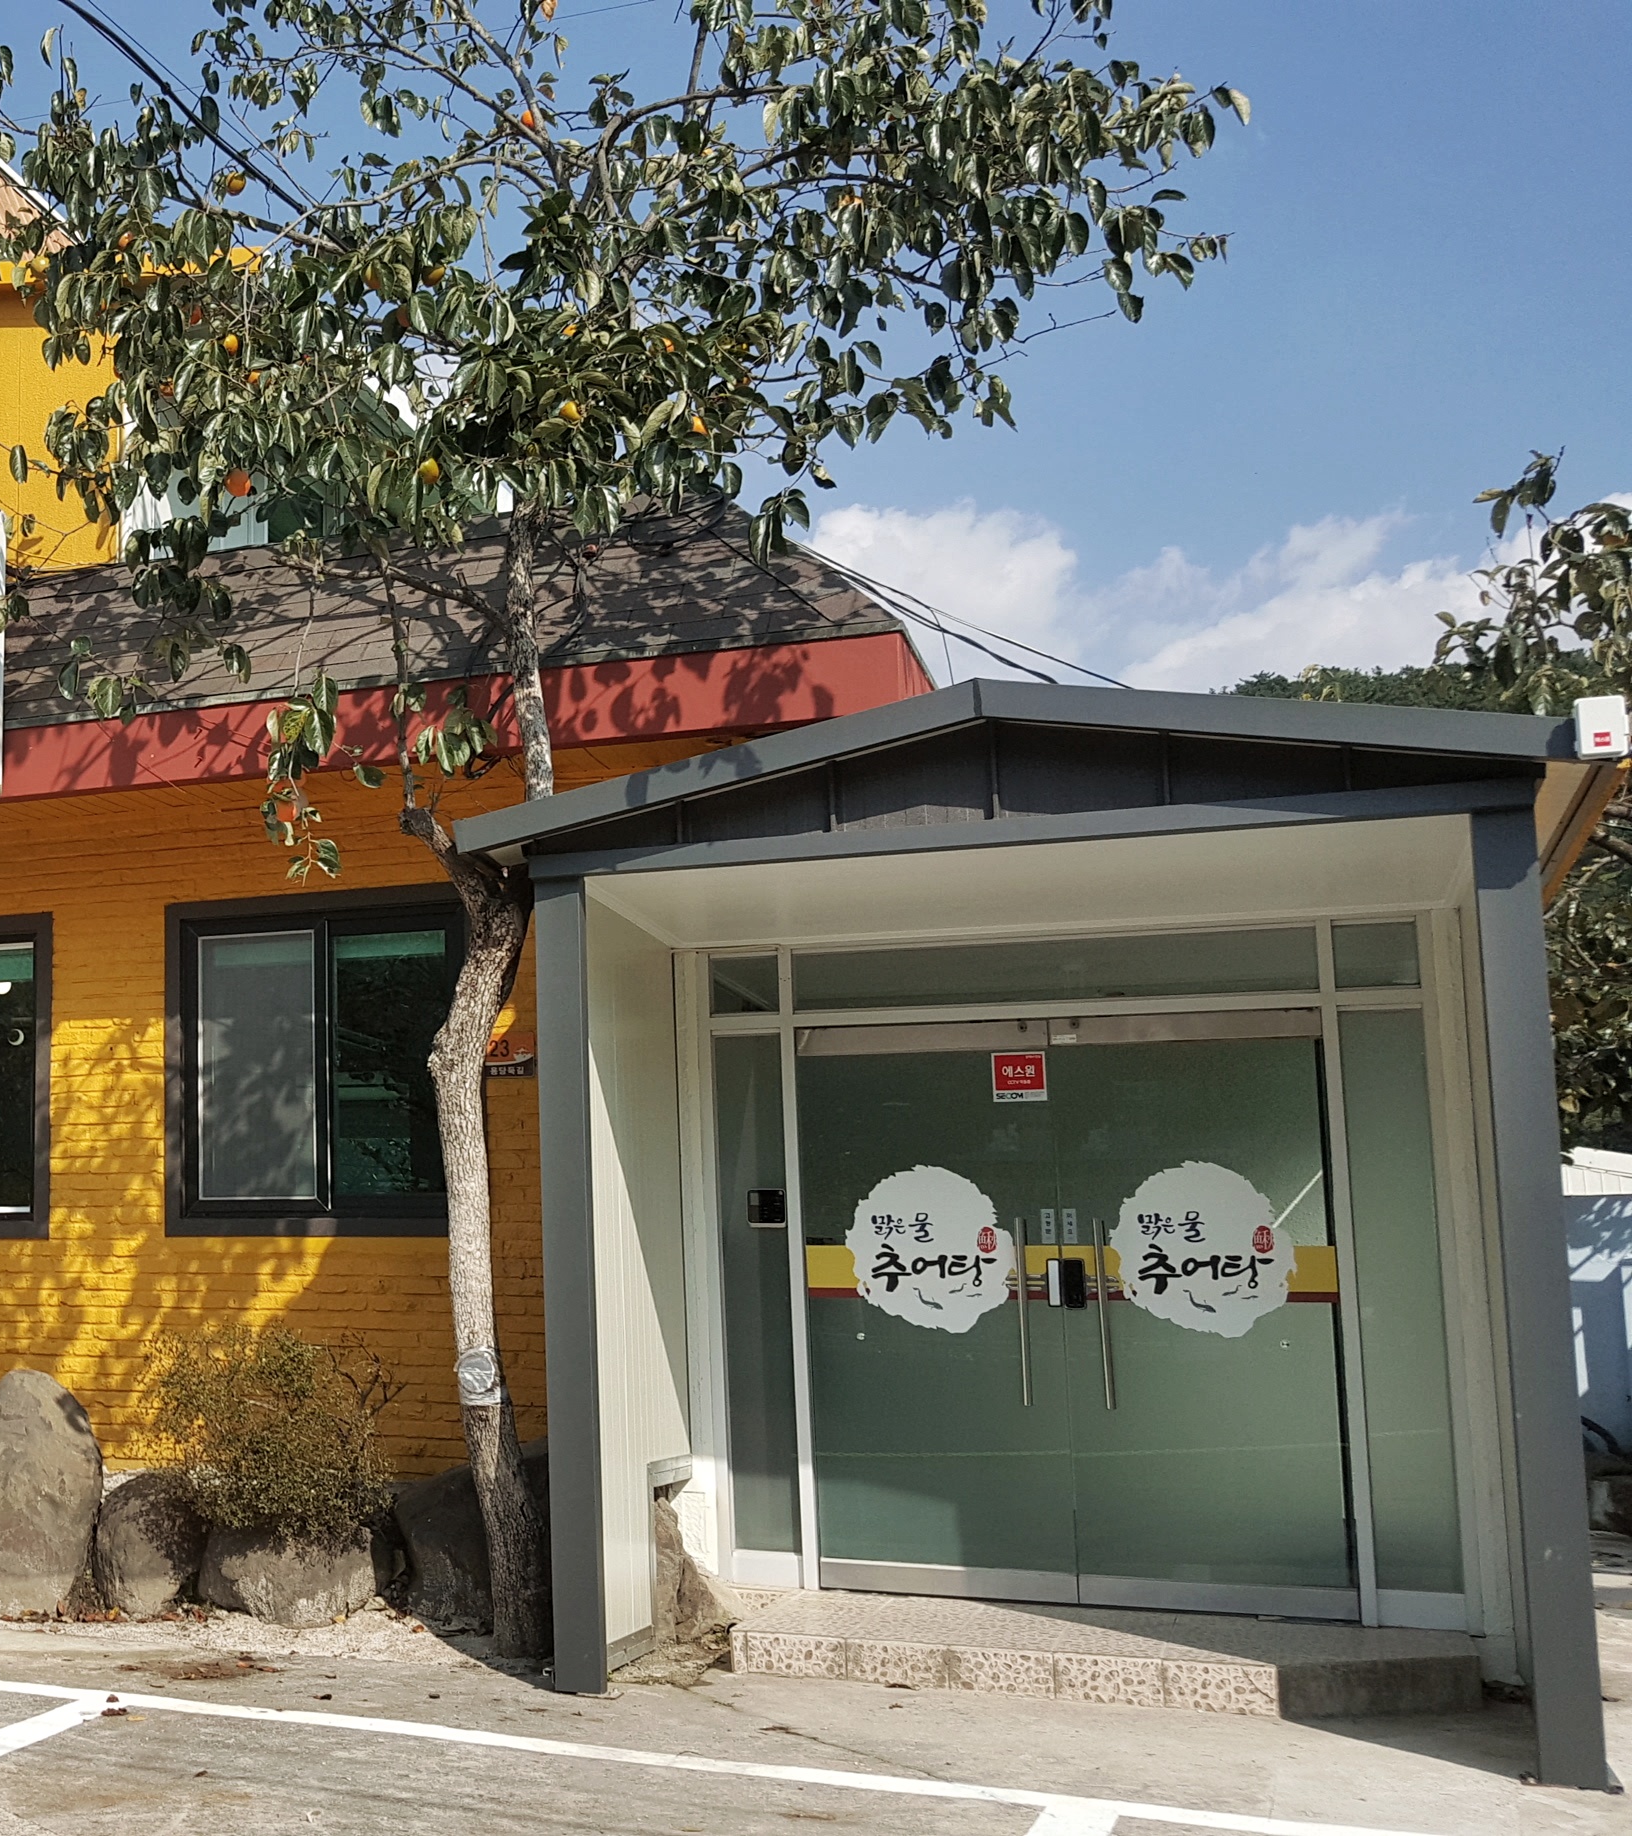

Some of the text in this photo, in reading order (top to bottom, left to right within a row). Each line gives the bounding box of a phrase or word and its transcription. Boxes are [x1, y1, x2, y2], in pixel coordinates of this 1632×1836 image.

[1002, 1065, 1035, 1077] 에스원
[996, 1092, 1024, 1100] SECOM
[871, 1212, 934, 1243] 맑은 물
[1137, 1211, 1206, 1243] 맑은 물
[871, 1243, 997, 1292] 추어탕
[1138, 1243, 1274, 1295] 추어탕
